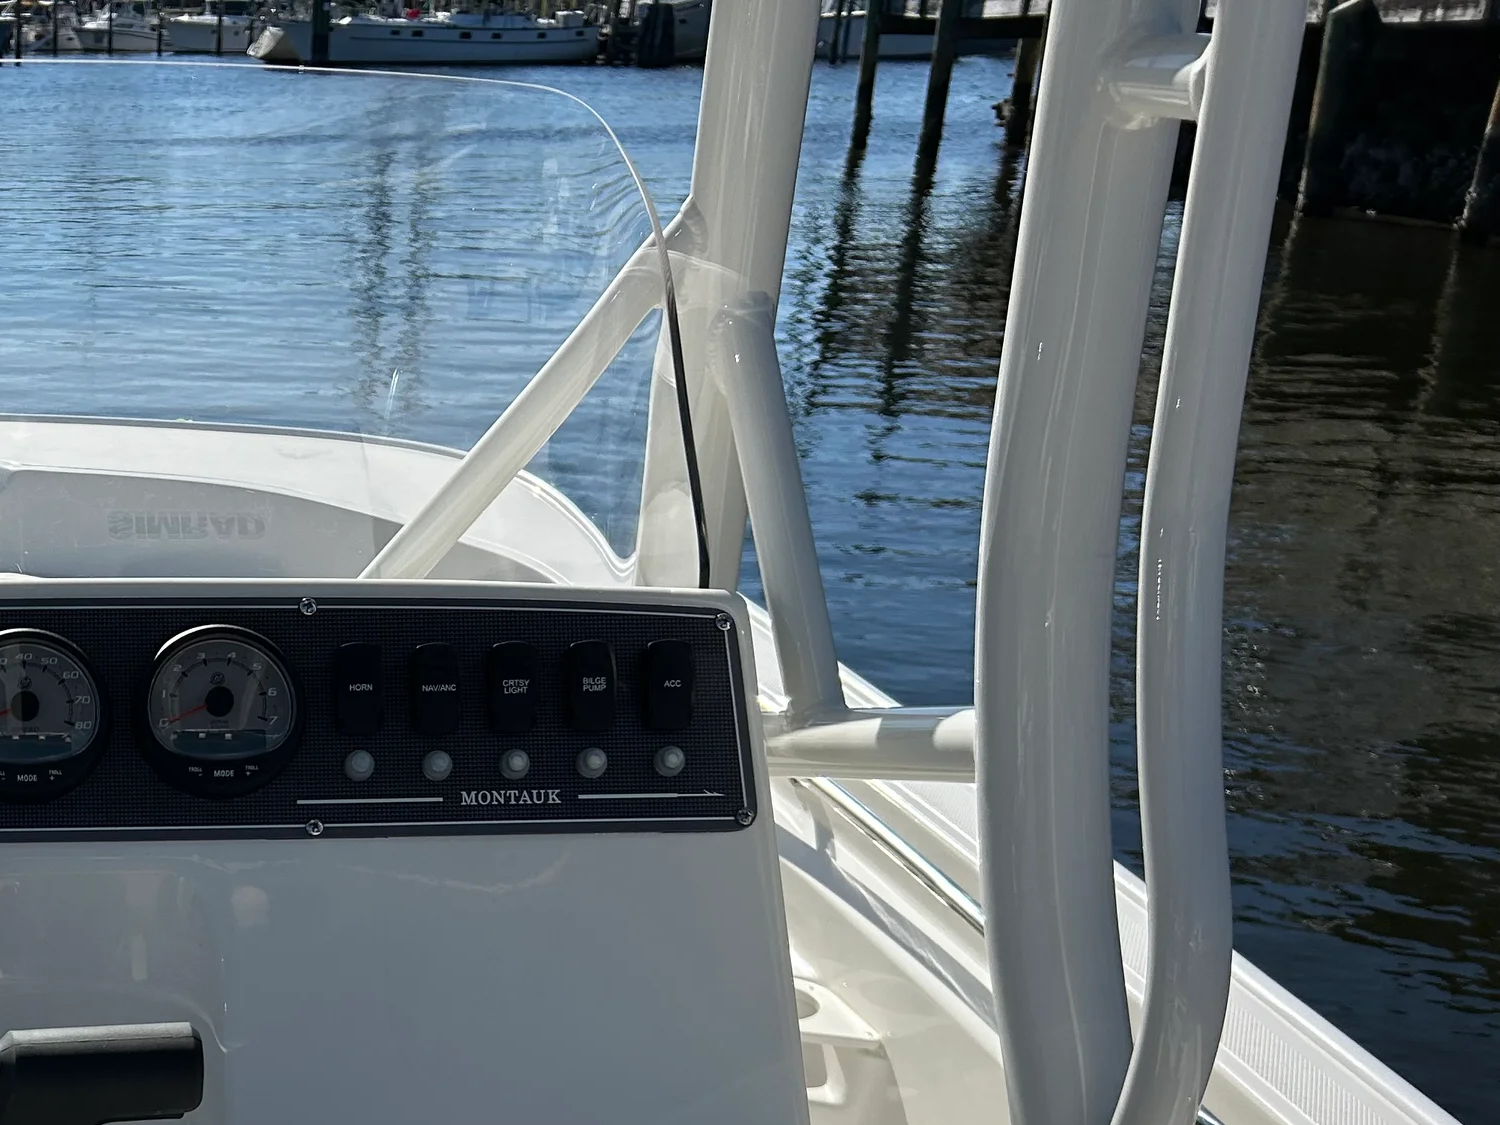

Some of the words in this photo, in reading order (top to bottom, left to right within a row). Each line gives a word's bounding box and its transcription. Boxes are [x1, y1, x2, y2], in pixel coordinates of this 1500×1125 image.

[15, 653, 33, 661] 40
[41, 657, 58, 665] 50
[62, 671, 79, 679] 60
[502, 679, 529, 688] CRTSY
[582, 676, 607, 685] BILGE
[663, 679, 682, 688] ACC
[349, 683, 373, 692] HORN
[422, 683, 457, 692] NAV/ANC
[504, 686, 528, 695] LIGHT
[583, 684, 607, 692] PUMP
[75, 696, 91, 704] 70
[75, 721, 92, 730] 80
[17, 774, 38, 782] MODE
[214, 769, 234, 778] MODE
[460, 790, 562, 806] MONTAUK
